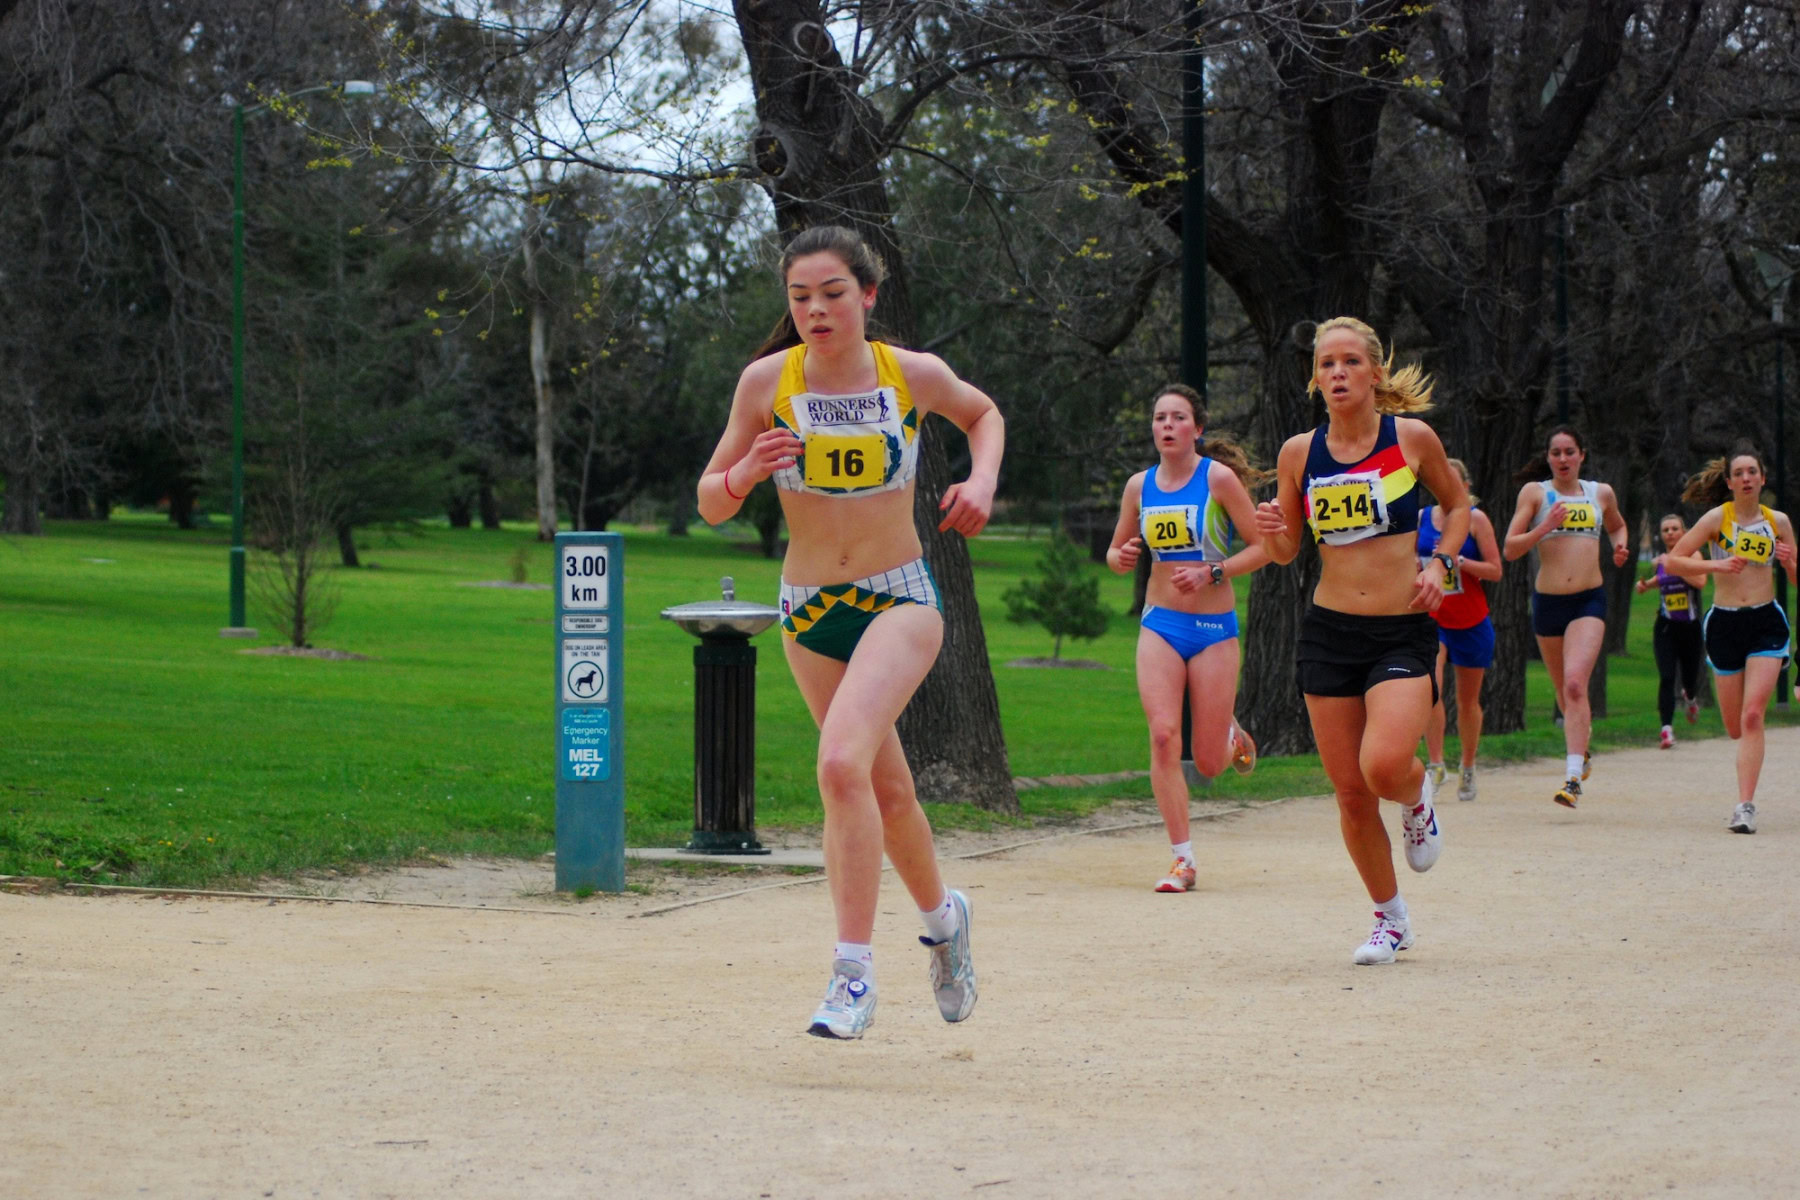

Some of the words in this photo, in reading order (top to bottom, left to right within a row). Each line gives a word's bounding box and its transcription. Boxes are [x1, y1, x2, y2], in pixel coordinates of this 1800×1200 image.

[808, 398, 876, 412] RUNNERS
[810, 410, 864, 423] WORLD
[826, 449, 864, 477] 16
[1315, 494, 1369, 521] 2-14
[1568, 509, 1587, 522] 20
[1155, 521, 1177, 540] 20
[1740, 538, 1766, 556] 3-5
[566, 555, 606, 577] 3.00
[572, 584, 598, 601] km
[1196, 620, 1223, 629] knox
[563, 726, 608, 736] Emergency
[571, 736, 600, 744] Marker
[568, 748, 603, 762] MEL
[572, 763, 600, 776] 127
